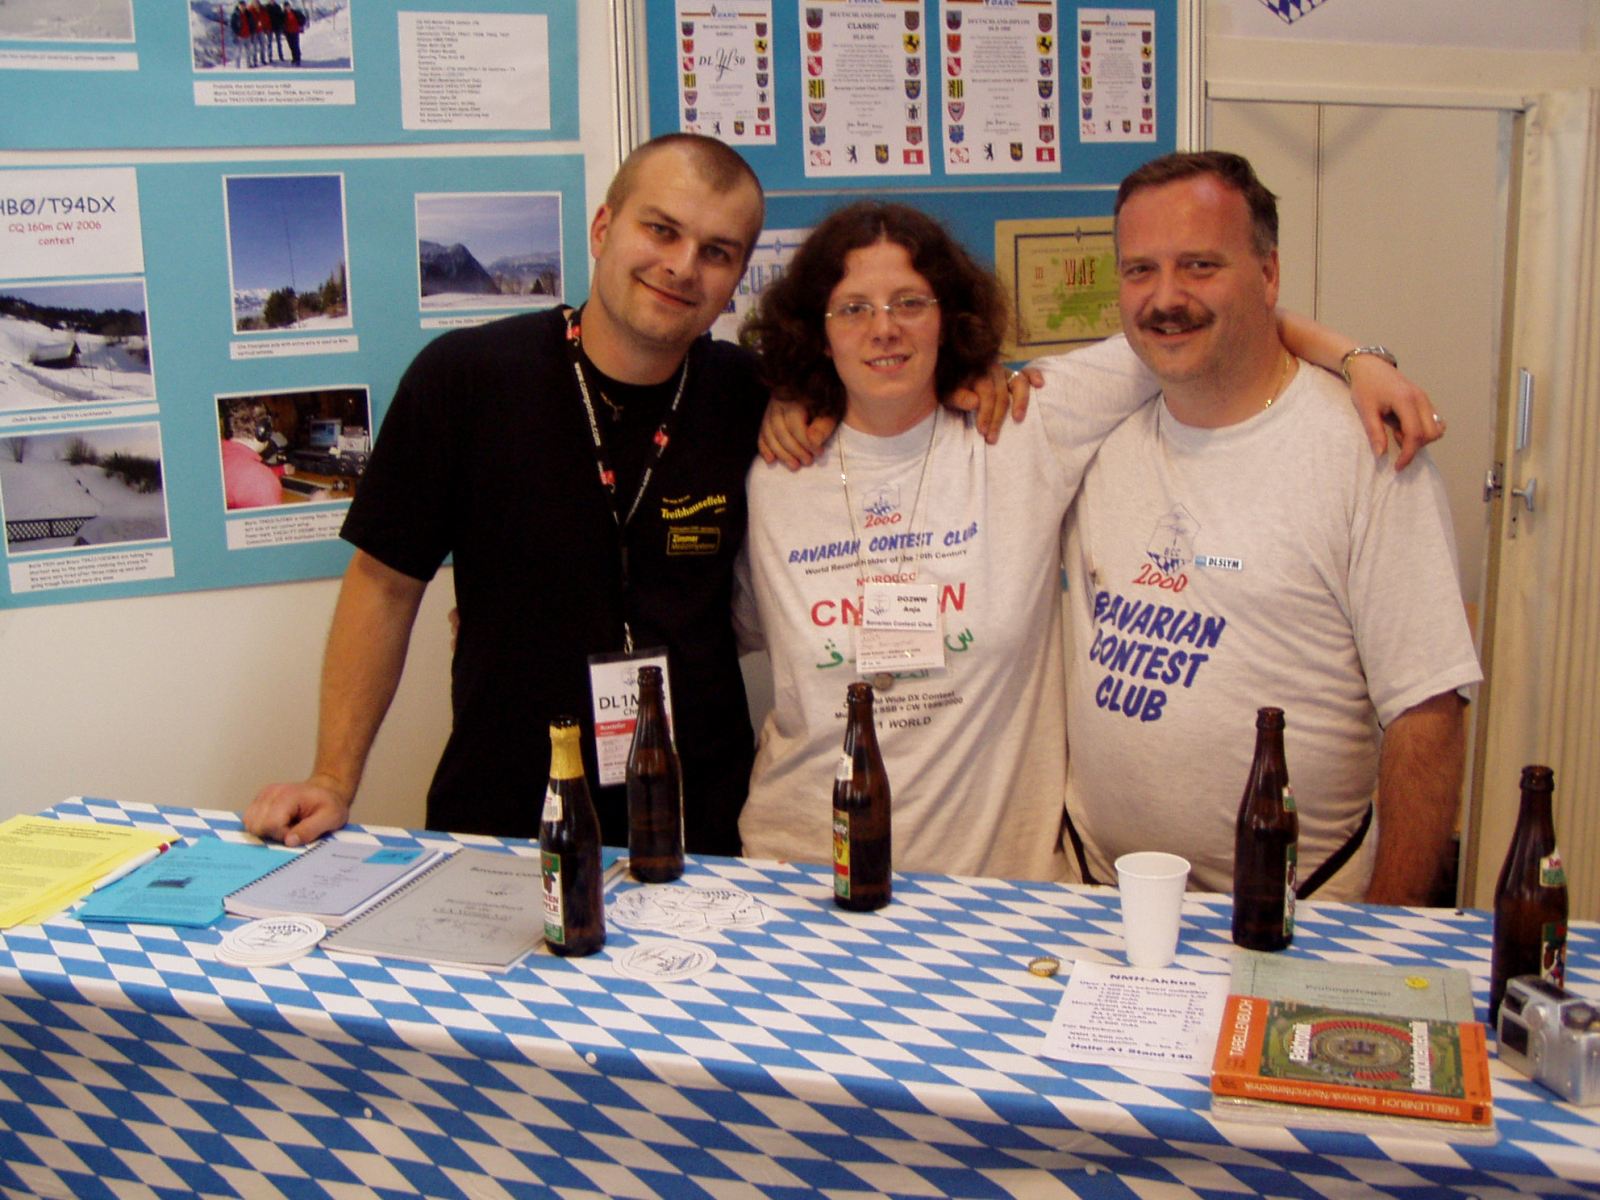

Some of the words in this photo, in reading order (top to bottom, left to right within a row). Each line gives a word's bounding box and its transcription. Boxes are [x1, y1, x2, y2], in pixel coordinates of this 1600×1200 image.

[847, 22, 880, 30] CLASSIC
[8, 223, 25, 233] CQ
[27, 222, 54, 232] 160m
[56, 221, 73, 231] CW
[76, 220, 102, 230] 2006
[38, 236, 75, 246] contest
[864, 513, 903, 529] 2000
[788, 538, 861, 564] BAVARIAN
[867, 531, 935, 553] CONTEST
[942, 520, 980, 547] CLUB
[804, 566, 830, 577] World
[889, 556, 899, 564] of
[935, 550, 968, 561] Century
[1131, 562, 1189, 593] 2000
[903, 605, 922, 615] Anja
[1094, 590, 1227, 649] BAVARIAN
[1089, 628, 1210, 689] CONTEST
[908, 692, 921, 702] DX
[922, 688, 957, 701] Contest
[1095, 674, 1168, 722] CLUB
[889, 715, 933, 729] WORLD
[1070, 1043, 1103, 1052] Halle
[1128, 1048, 1165, 1059] Stand
[1381, 1097, 1461, 1116] TABELLENBUCH
